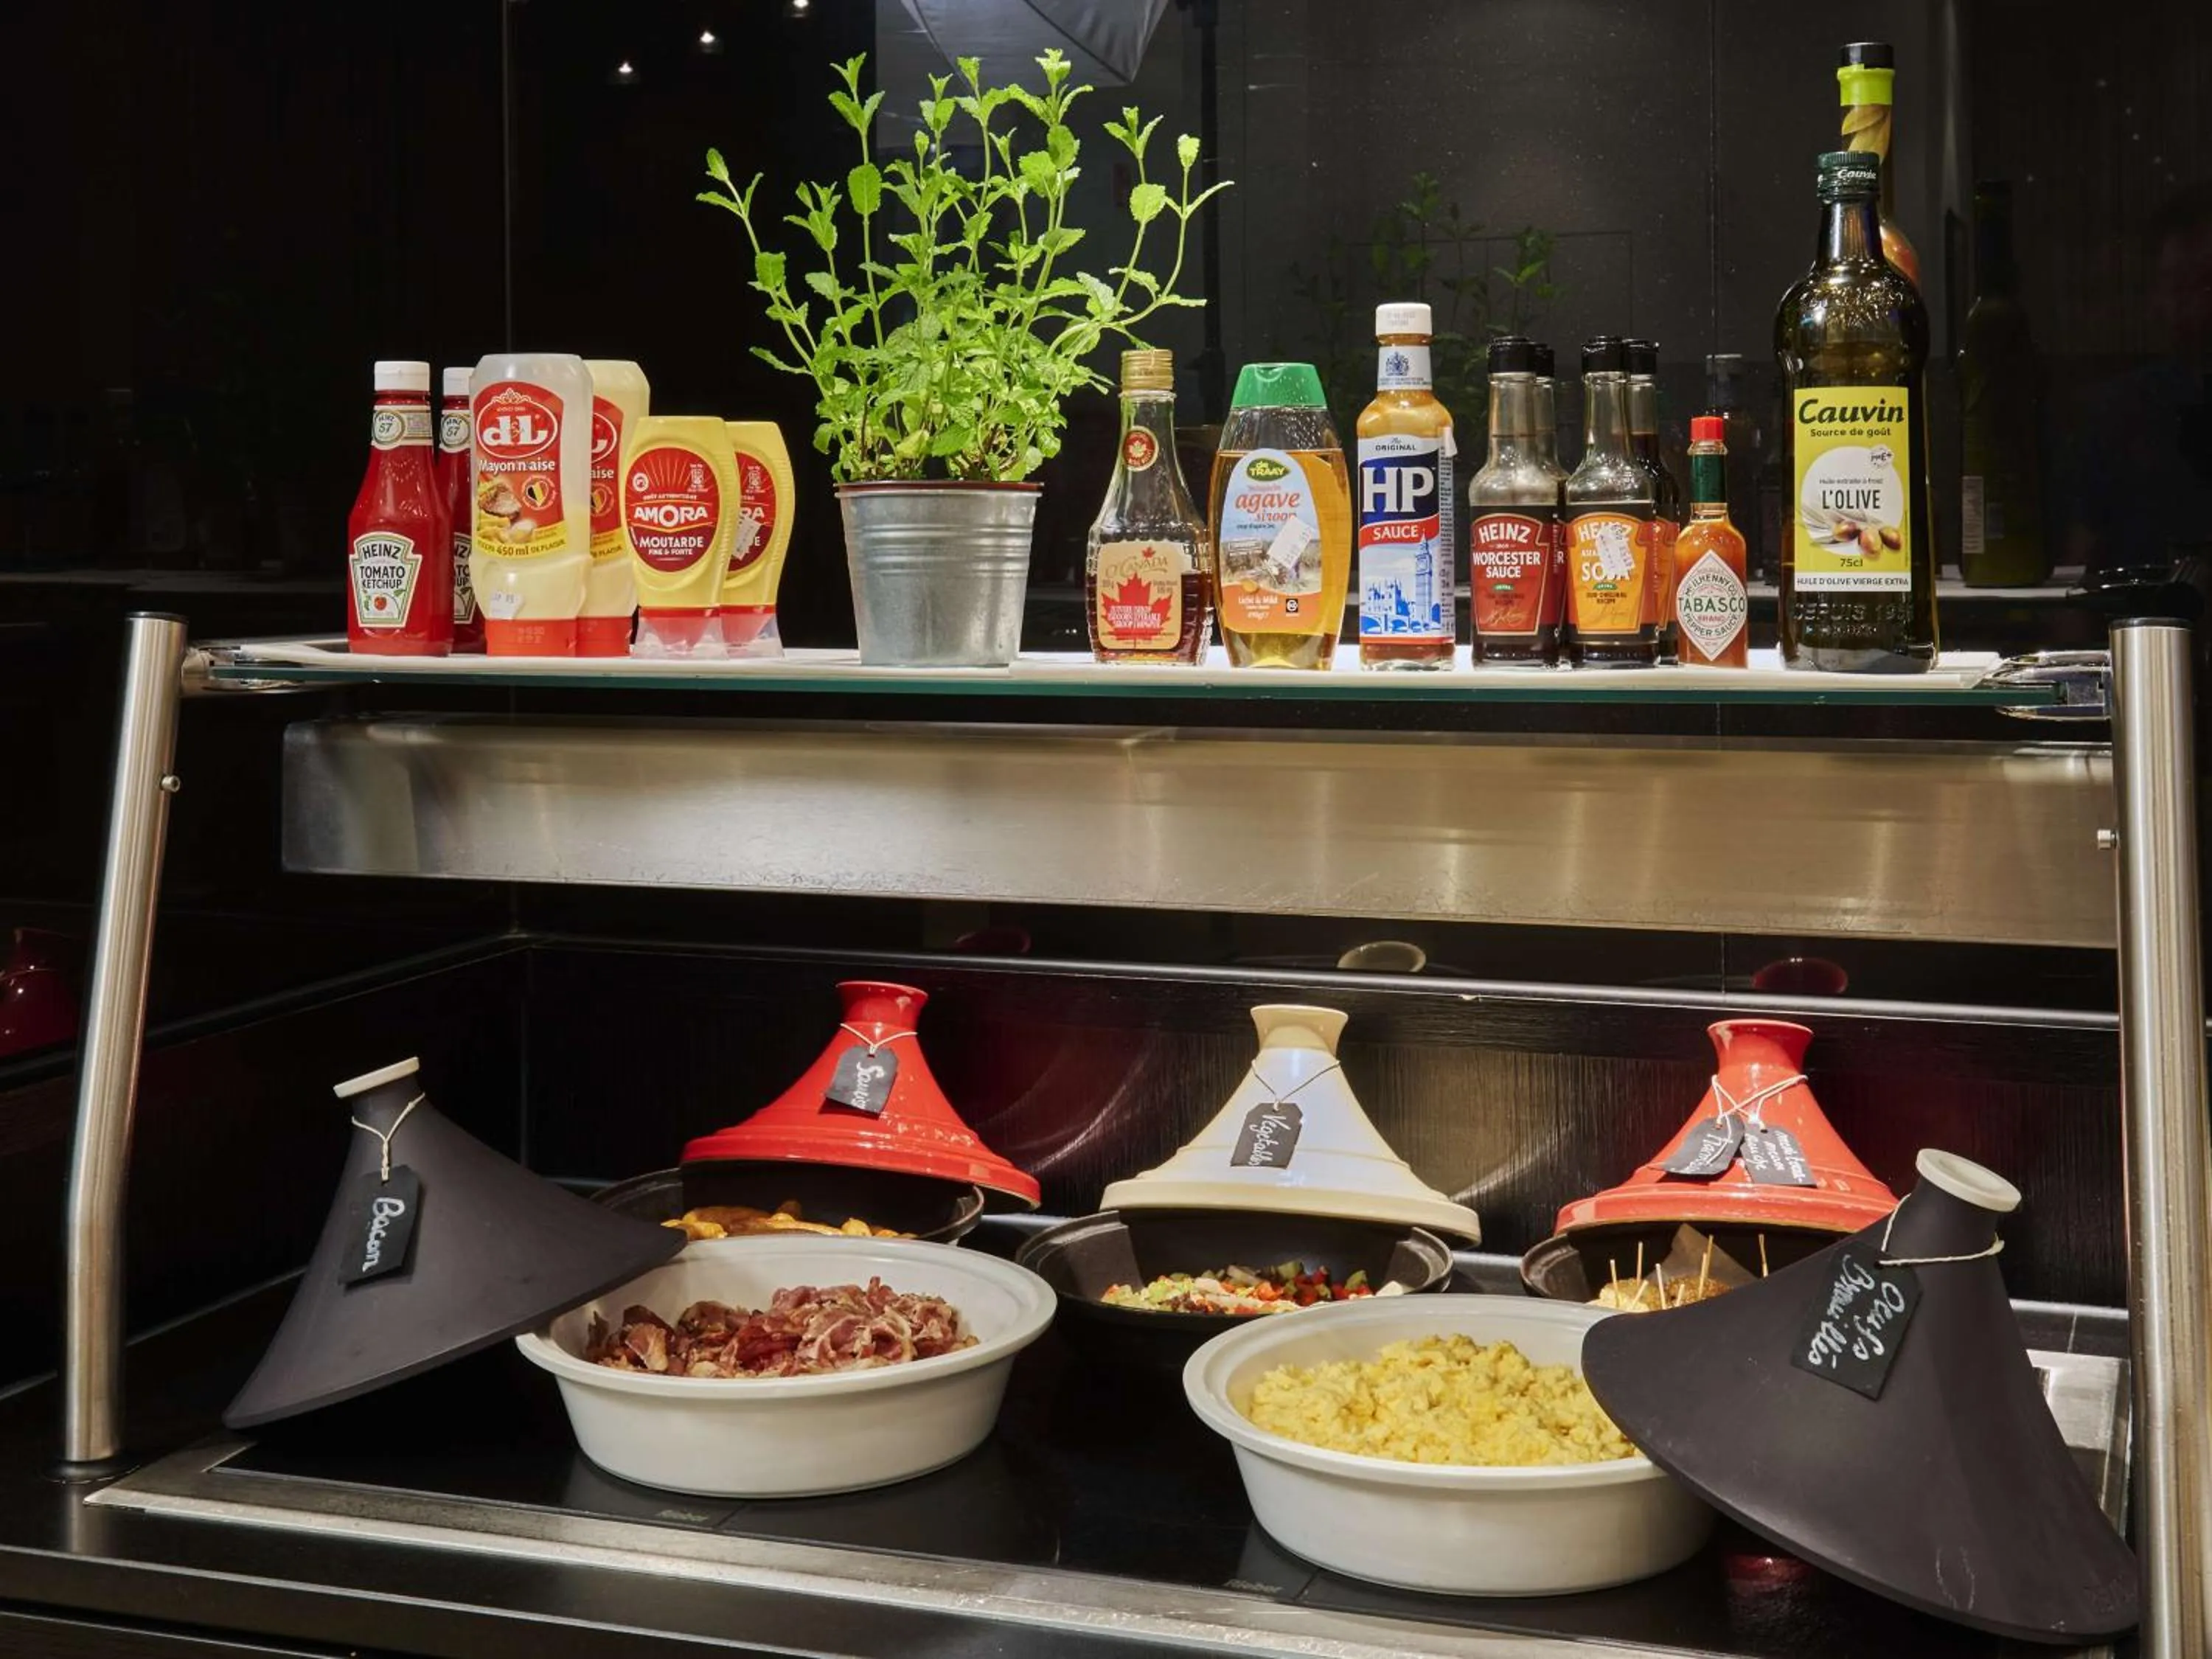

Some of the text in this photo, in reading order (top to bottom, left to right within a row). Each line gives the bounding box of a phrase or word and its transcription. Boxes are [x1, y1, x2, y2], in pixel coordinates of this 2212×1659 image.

[1798, 398, 1905, 425] Cauvin
[378, 422, 392, 434] 57
[1810, 427, 1891, 439] Source de goût
[1249, 467, 1285, 476] TRAAY
[1363, 467, 1434, 512] HP
[1235, 492, 1301, 513] agave
[1822, 490, 1881, 509] L'OLIVE
[634, 504, 708, 527] AMORA
[1373, 524, 1419, 540] SAUCE
[1478, 523, 1531, 543] HEINZ
[1578, 521, 1632, 542] HEZ
[639, 536, 704, 548] MOUTARDE
[362, 543, 402, 560] HEINZ
[496, 546, 514, 555] 450
[515, 546, 529, 554] ml
[1472, 551, 1540, 566] WORCESTER
[1840, 558, 1864, 567] 75cl
[360, 566, 405, 578] TOMATO
[1486, 566, 1521, 579] SAUCE
[362, 580, 402, 589] KETCHUP
[1678, 597, 1745, 613] TABASCO
[362, 1197, 405, 1272] Bacon
[1852, 1281, 1905, 1360] Oeufs
